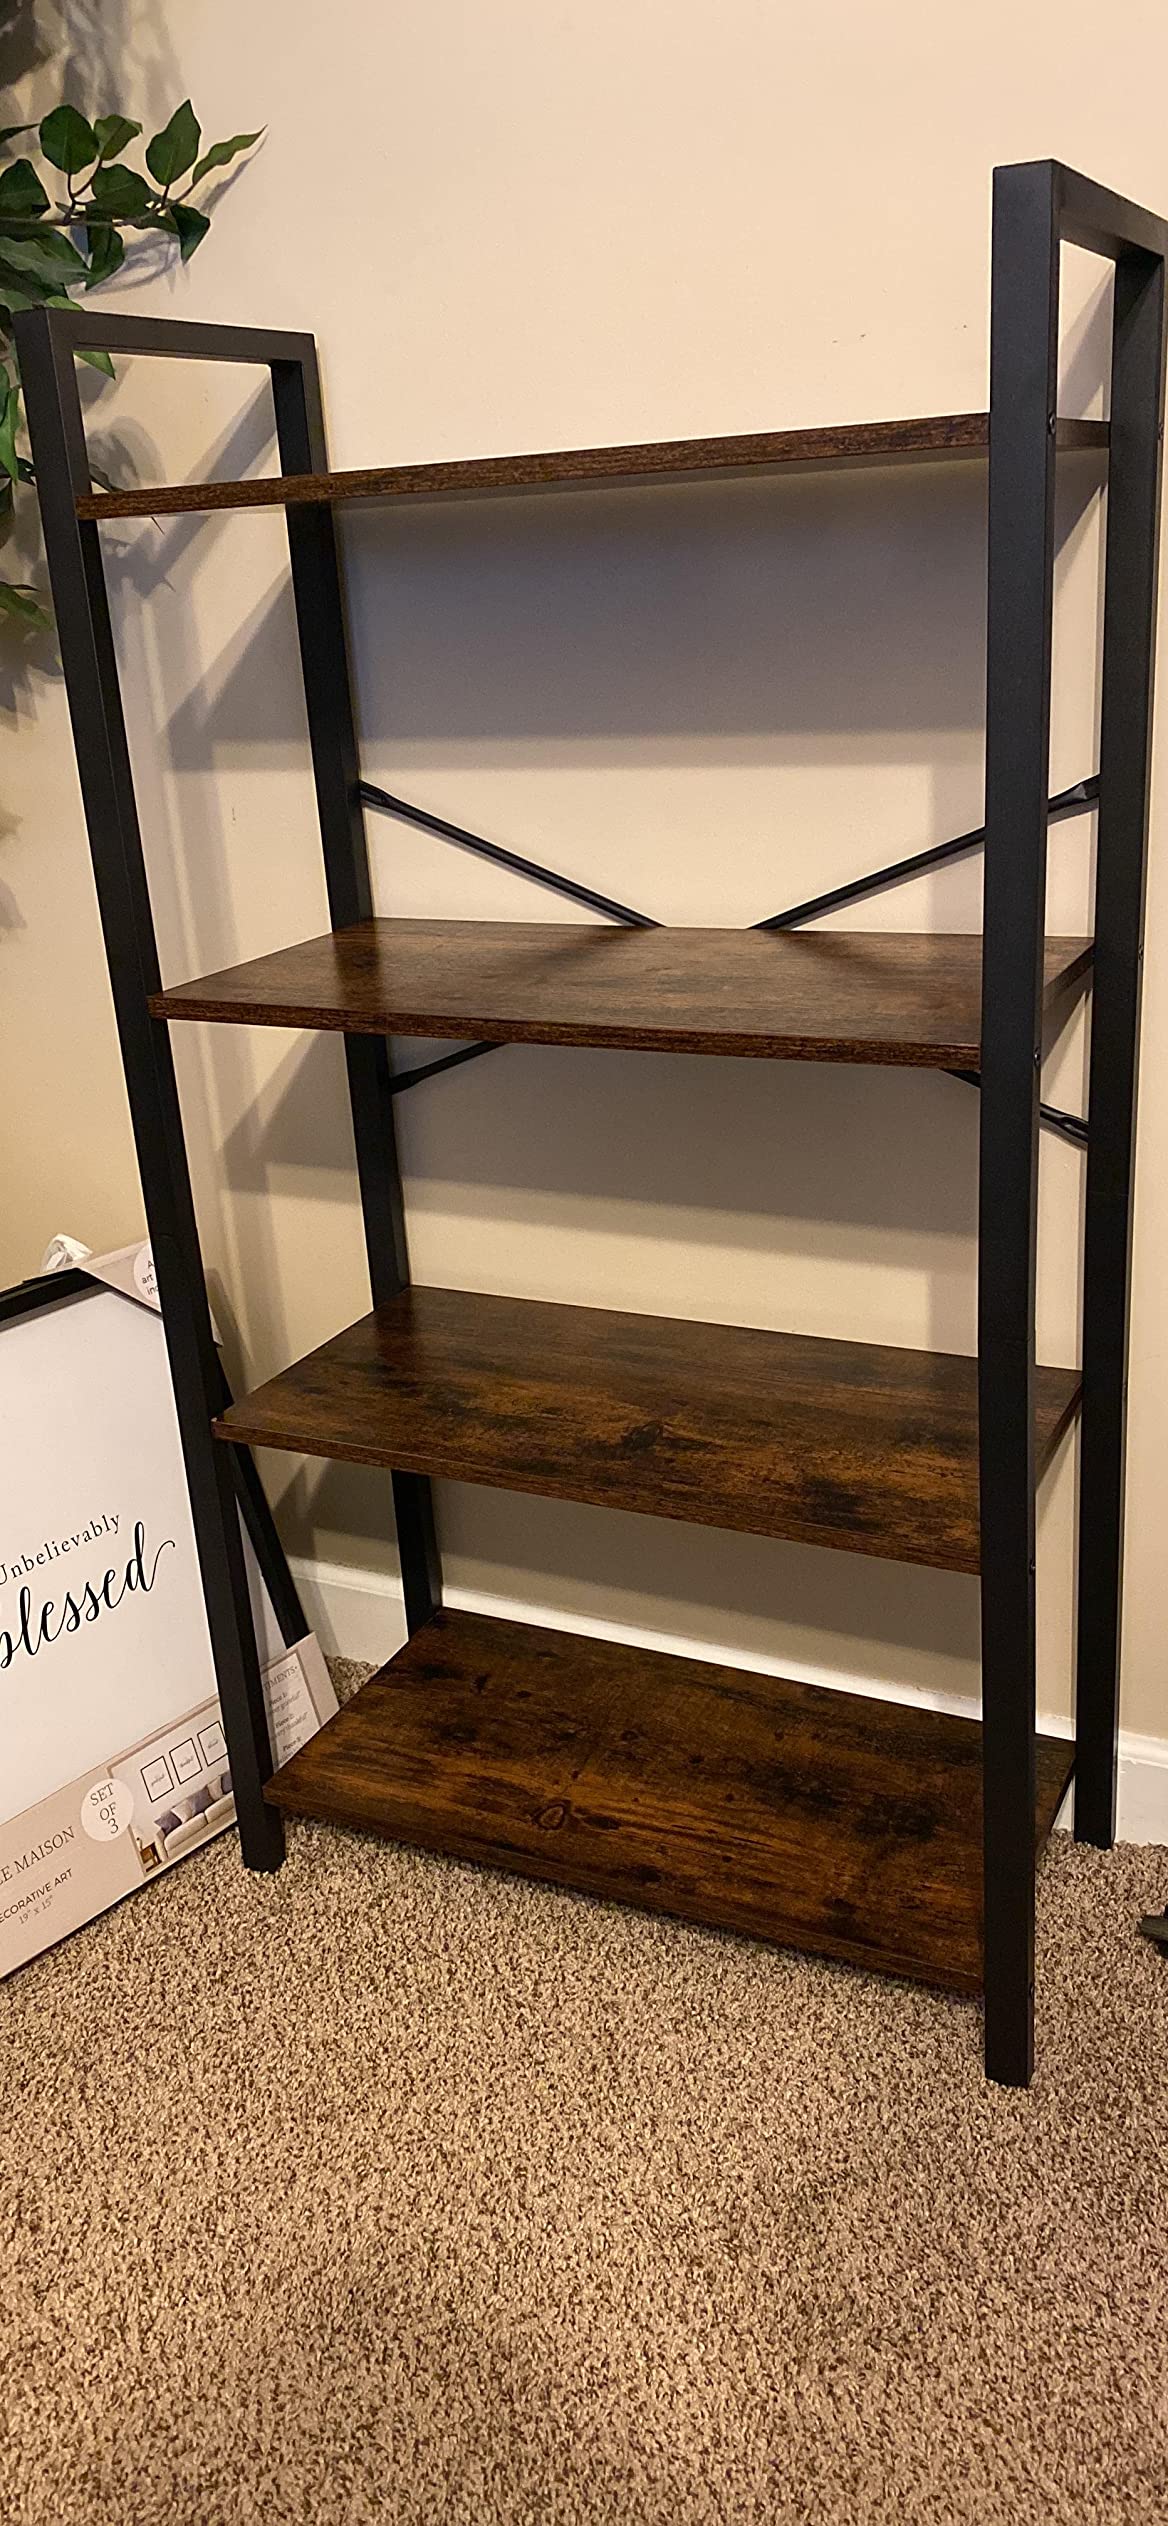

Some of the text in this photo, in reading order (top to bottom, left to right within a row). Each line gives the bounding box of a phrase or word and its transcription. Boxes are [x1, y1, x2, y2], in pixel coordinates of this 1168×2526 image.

[141, 1274, 154, 1284] art
[90, 1782, 114, 1806] SET
[99, 1801, 116, 1821] OF
[107, 1817, 119, 1834] 3
[0, 1825, 75, 1886] E MAISON
[54, 1868, 72, 1887] ART
